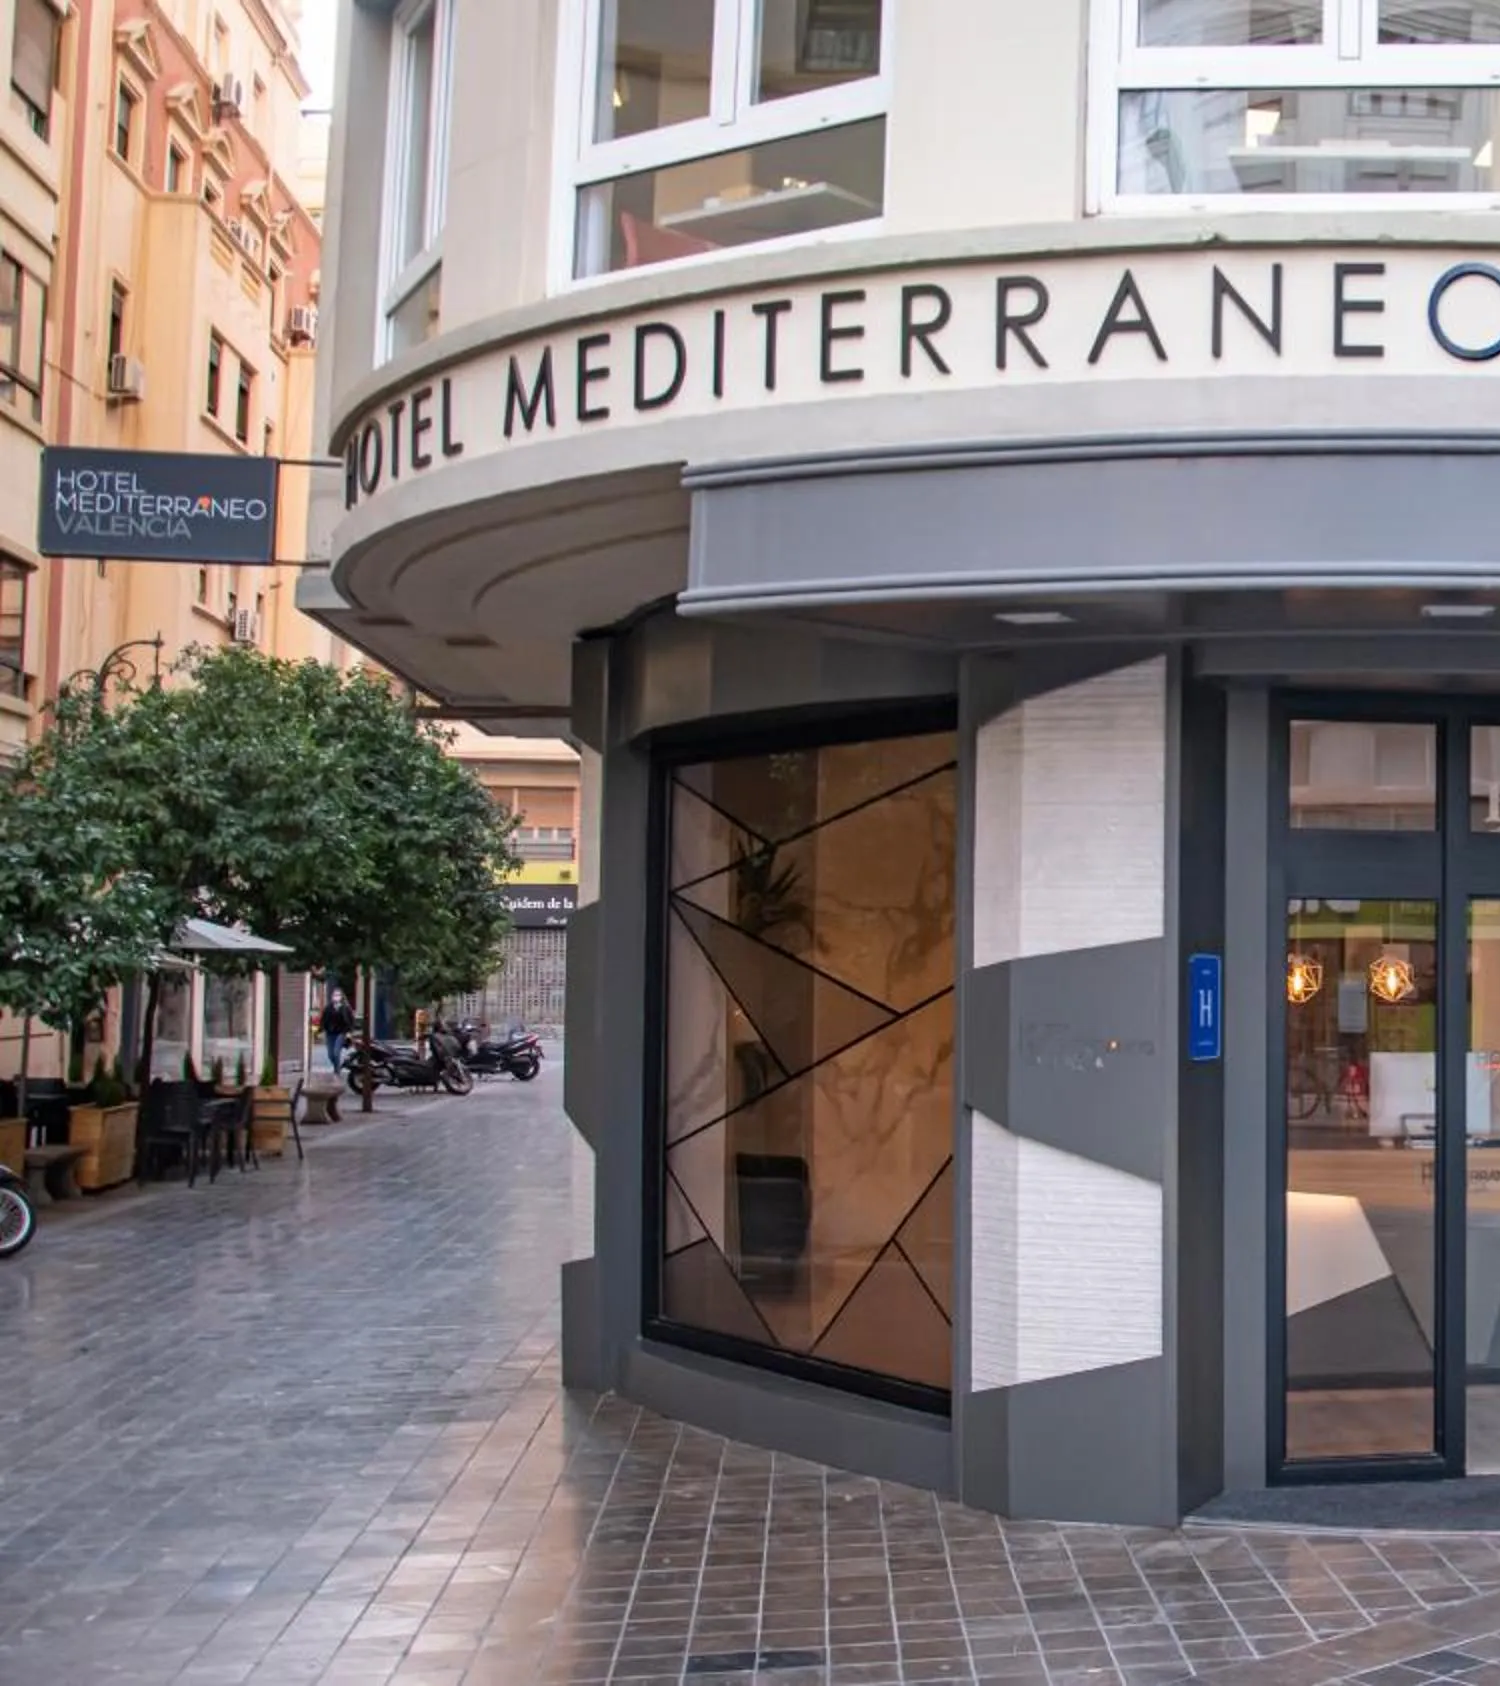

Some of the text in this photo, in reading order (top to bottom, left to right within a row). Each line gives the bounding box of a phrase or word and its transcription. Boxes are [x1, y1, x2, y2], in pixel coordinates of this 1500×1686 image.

[345, 378, 464, 511] HOTEL
[56, 469, 146, 494] HOTEL
[55, 491, 268, 521] MEDITERRANEO
[56, 512, 192, 539] VALENCIA
[547, 897, 561, 909] de
[1199, 989, 1212, 1028] H
